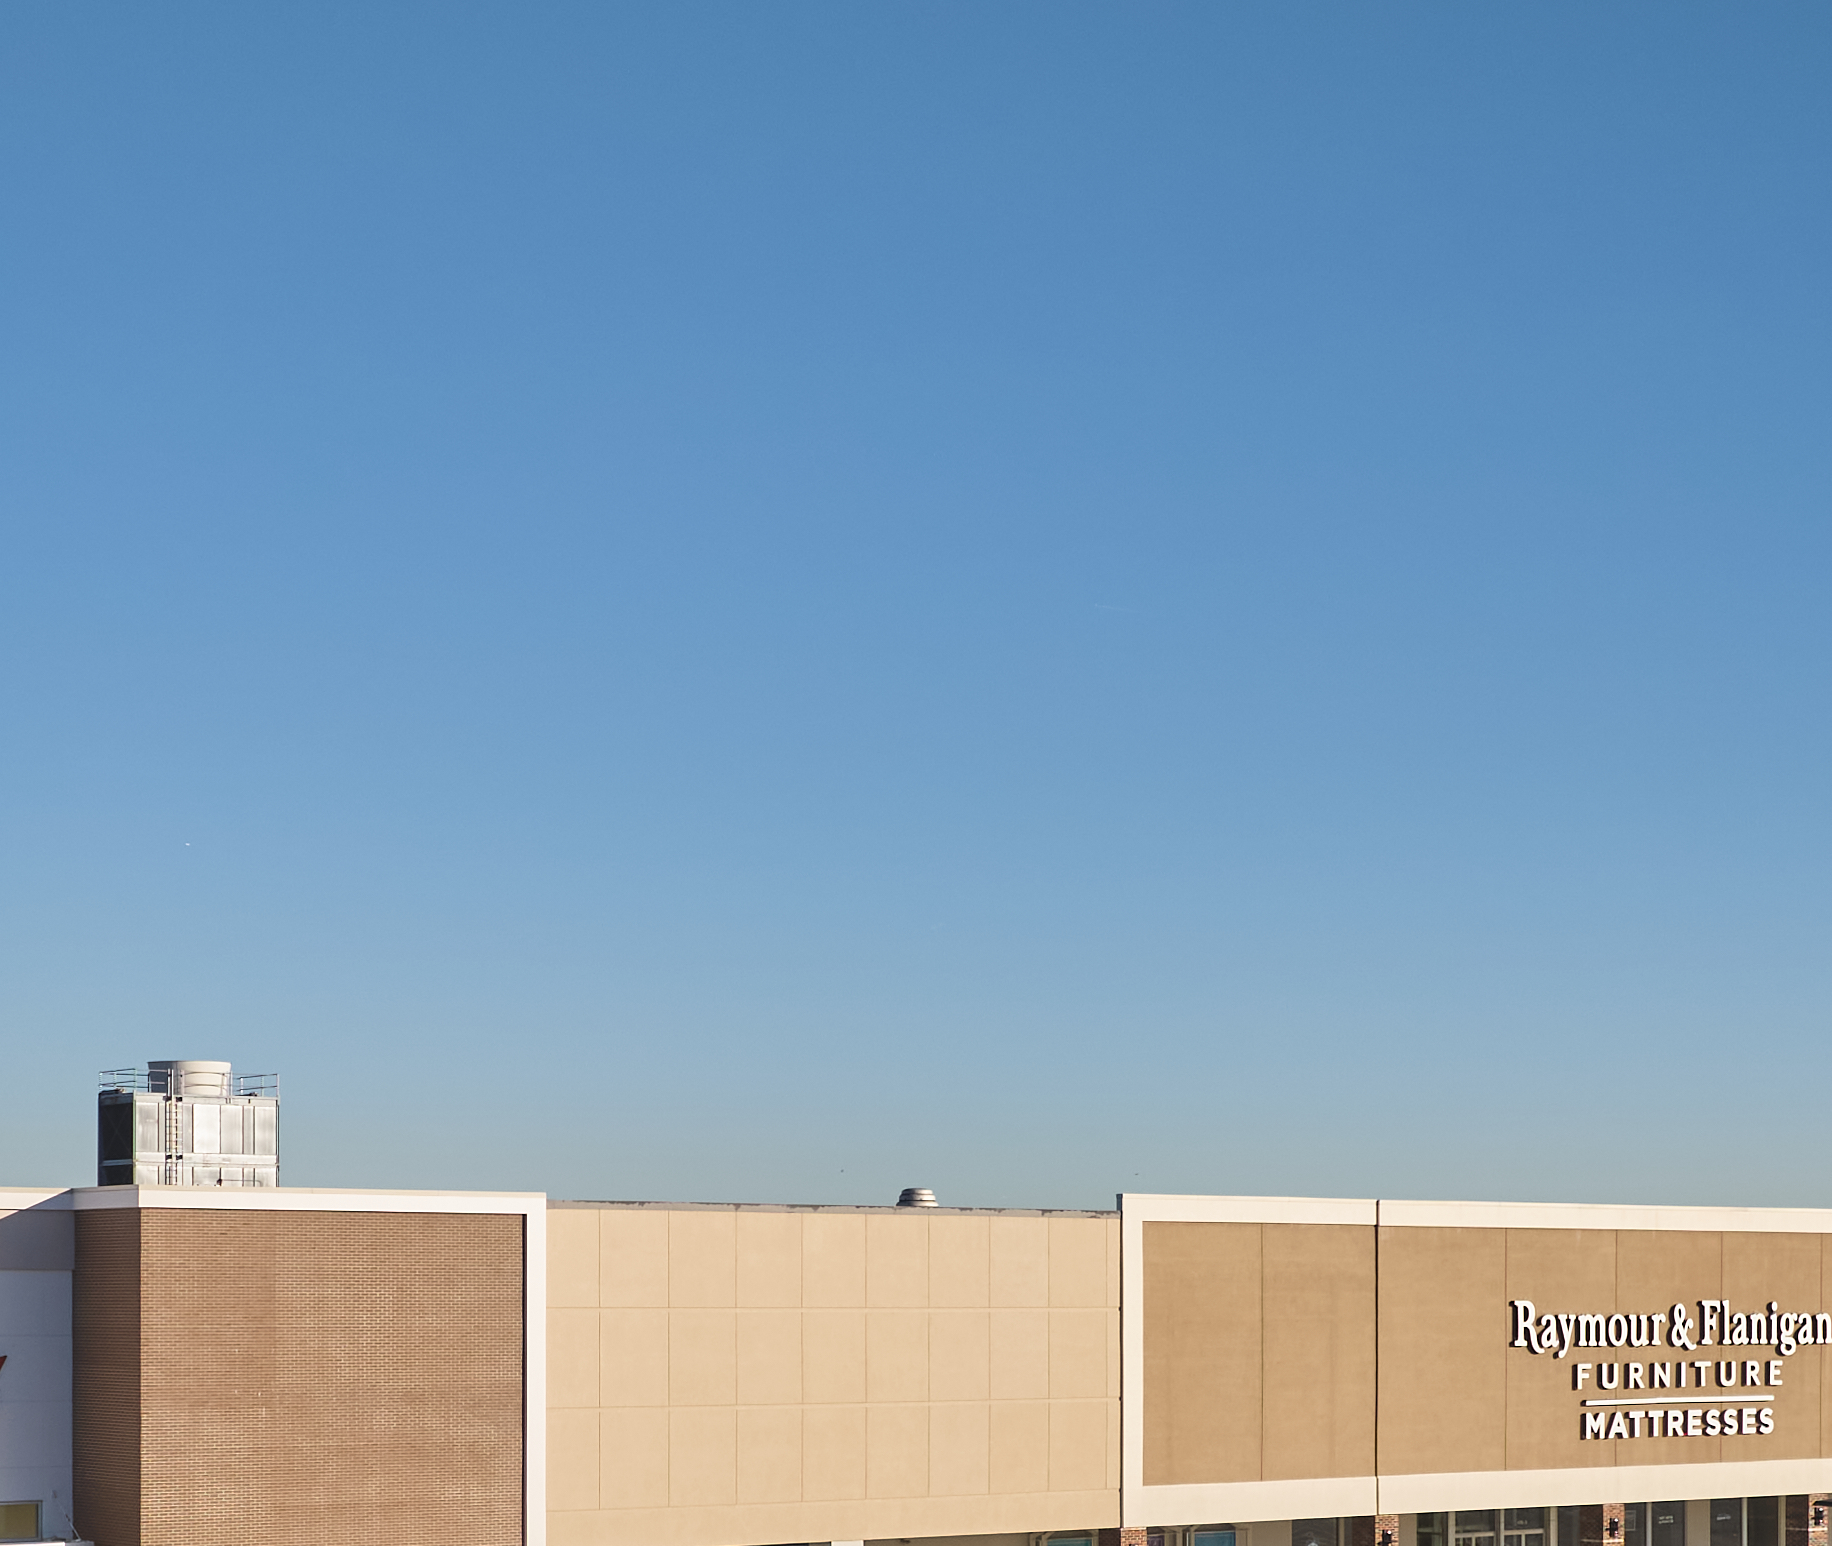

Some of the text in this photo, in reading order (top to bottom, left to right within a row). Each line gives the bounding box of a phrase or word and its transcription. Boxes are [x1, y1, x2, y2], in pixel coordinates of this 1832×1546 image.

[1511, 1299, 1832, 1358] Raymour & Flanigan
[1573, 1360, 1784, 1390] FURNITURE
[1581, 1408, 1775, 1440] MATTRESSES
